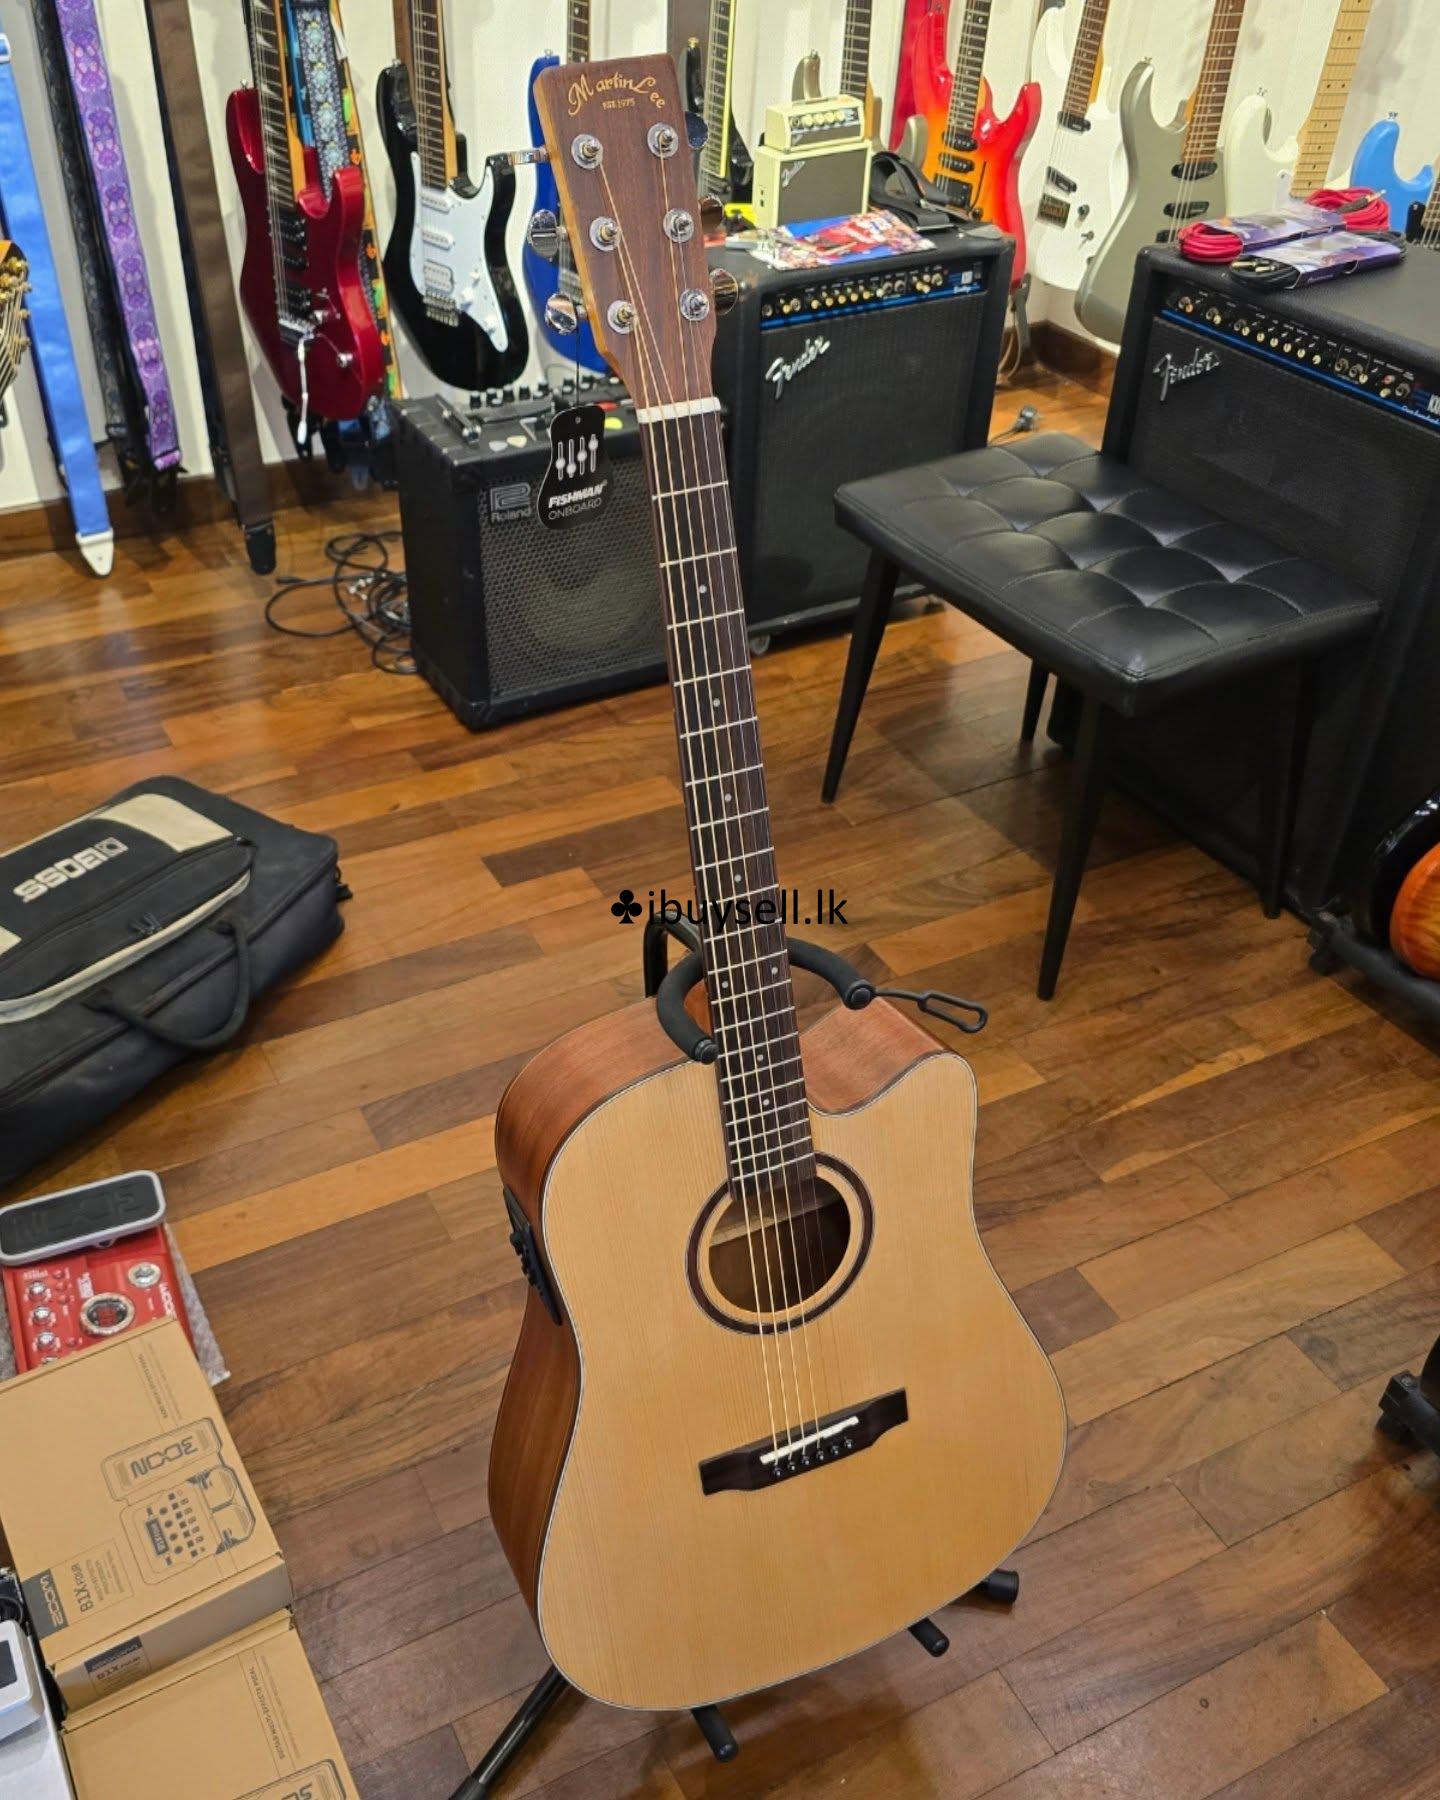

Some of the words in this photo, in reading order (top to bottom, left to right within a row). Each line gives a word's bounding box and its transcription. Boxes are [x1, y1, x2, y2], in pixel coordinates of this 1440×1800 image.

[567, 72, 634, 117] Martin
[765, 335, 831, 400] Fender
[1153, 348, 1222, 401] Fender
[490, 505, 531, 523] Roland
[548, 480, 608, 508] FISHMAN
[549, 497, 602, 520] ONBOARD
[13, 847, 109, 903] BOSS
